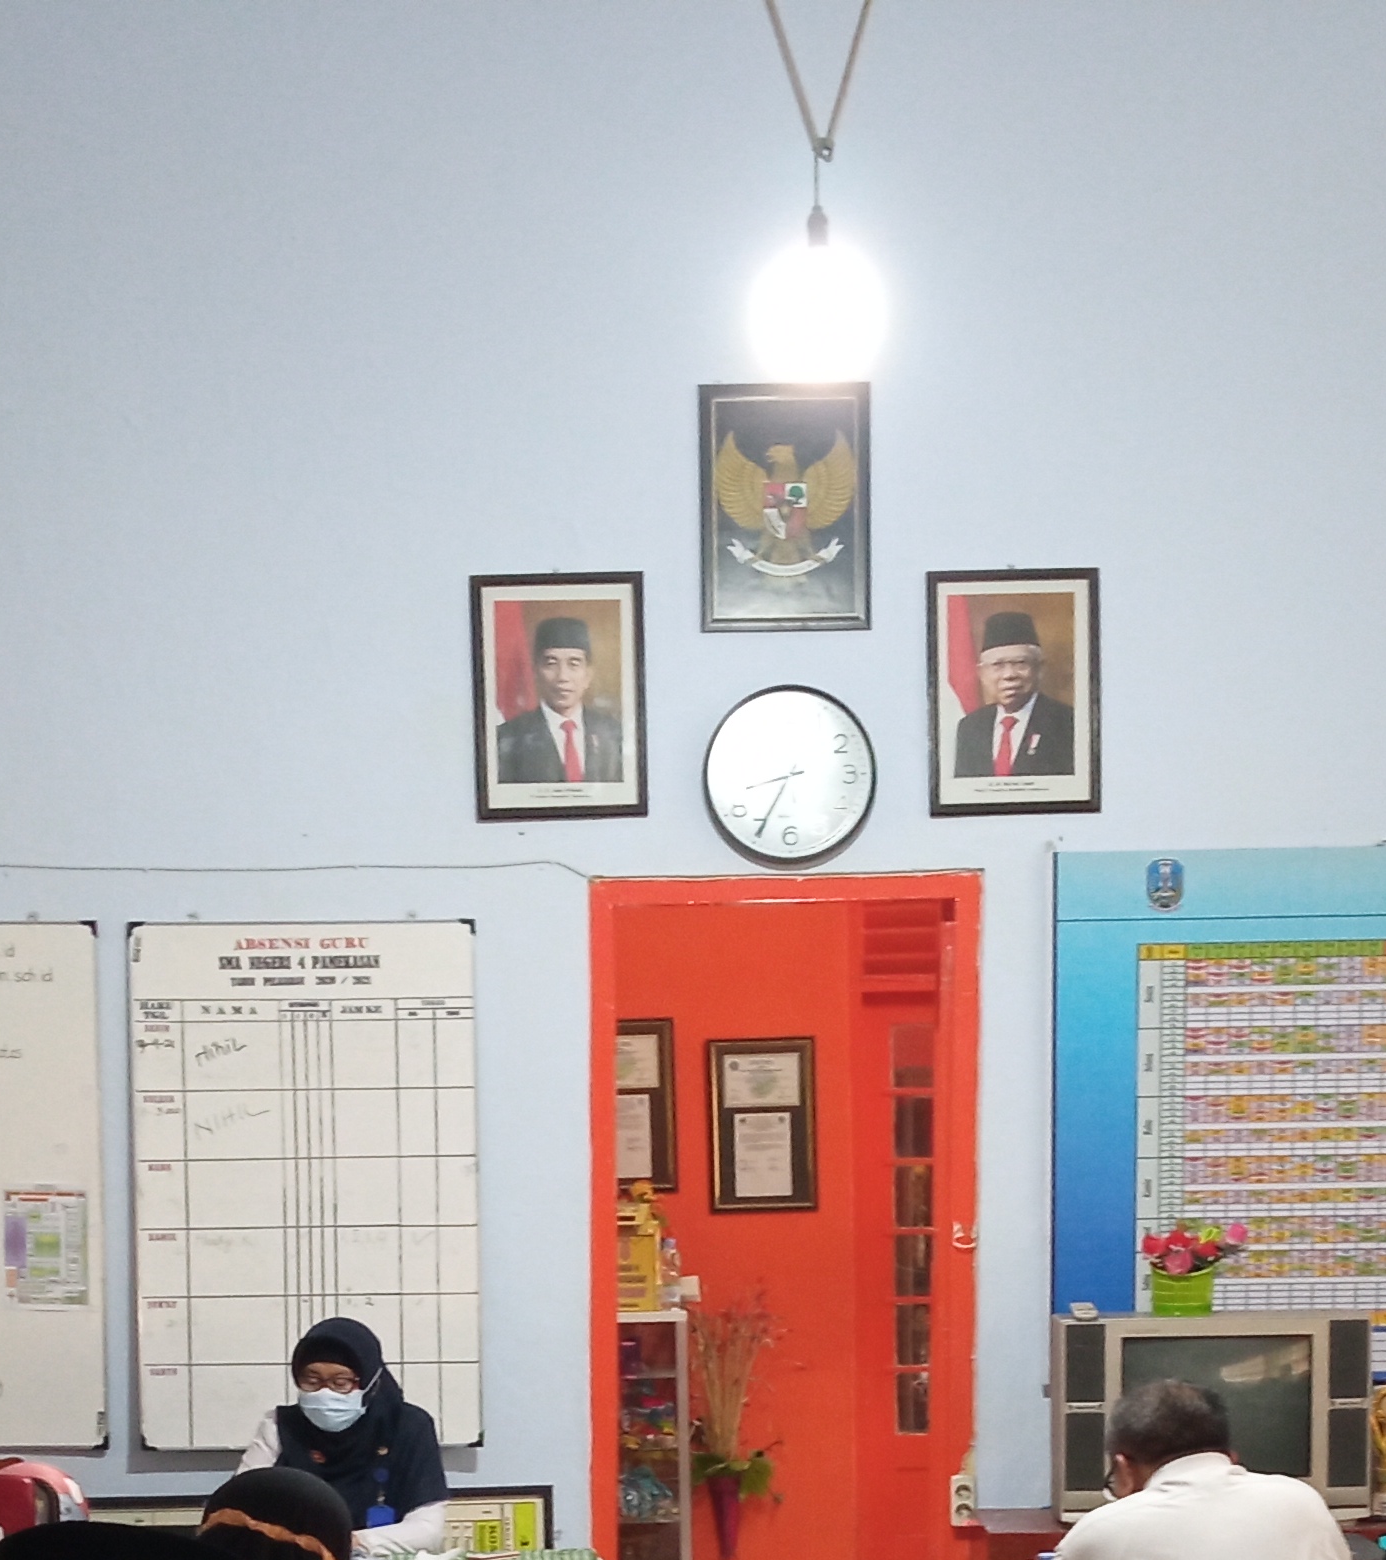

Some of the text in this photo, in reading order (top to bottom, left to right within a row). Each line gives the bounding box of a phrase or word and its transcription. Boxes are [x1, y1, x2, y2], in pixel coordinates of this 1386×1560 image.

[842, 764, 858, 785] 3
[234, 936, 370, 951] ABSENSI GURU
[218, 954, 381, 970] SMA NEGERI 4 PAMEKASAN
